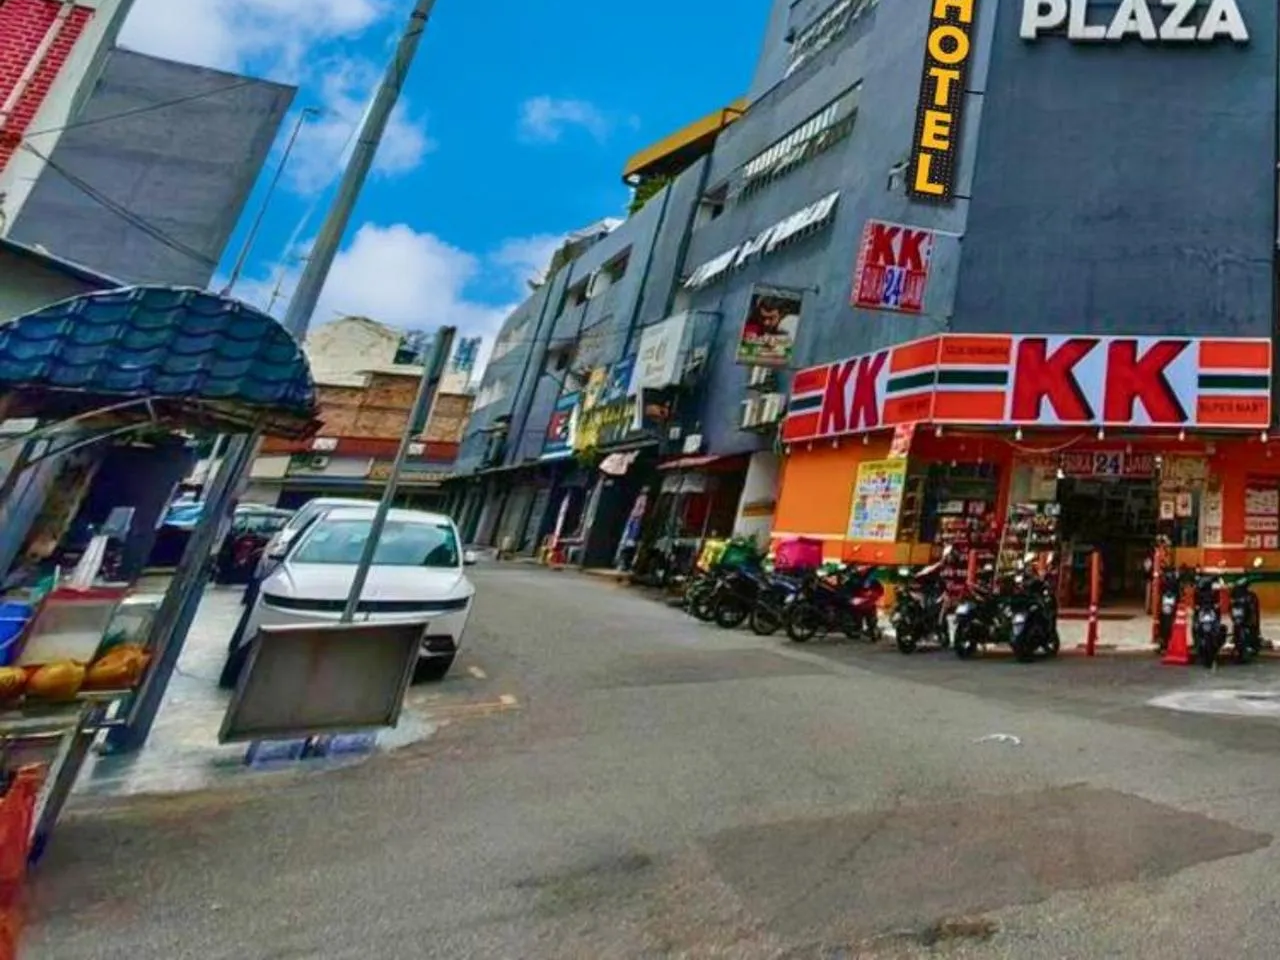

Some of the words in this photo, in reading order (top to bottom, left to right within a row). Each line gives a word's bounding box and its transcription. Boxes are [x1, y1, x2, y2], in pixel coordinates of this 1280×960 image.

[865, 223, 929, 273] KK
[820, 350, 890, 435] KK
[1010, 338, 1193, 423] KK
[1097, 451, 1121, 474] 24
